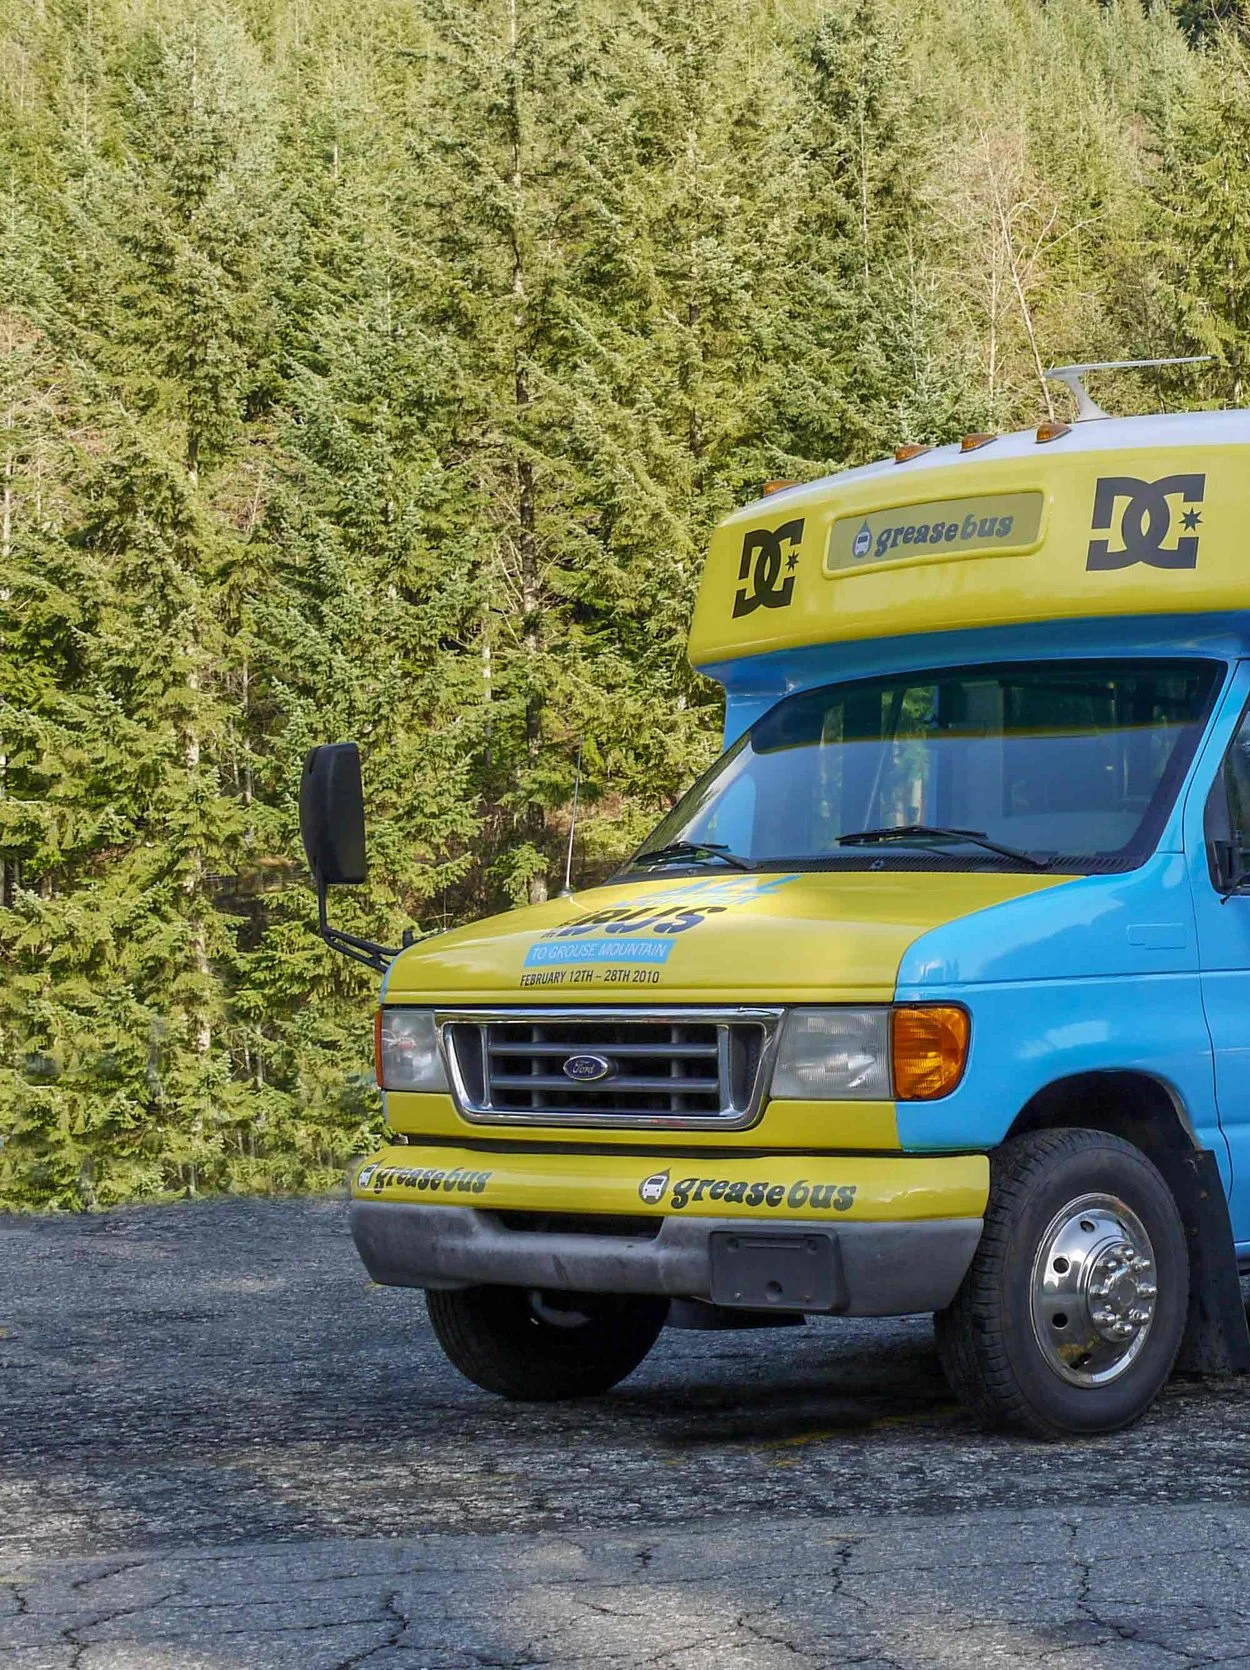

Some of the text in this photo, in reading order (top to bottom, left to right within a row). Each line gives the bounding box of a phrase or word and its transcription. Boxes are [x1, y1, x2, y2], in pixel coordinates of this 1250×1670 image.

[1085, 474, 1206, 571] DC
[731, 518, 805, 618] DC
[557, 906, 728, 937] BUS
[531, 942, 668, 960] TO GROUSE MOUNTAIN
[520, 970, 566, 986] FEBRUARY
[569, 970, 593, 983] 12TH
[604, 970, 630, 982] 28TH
[632, 970, 660, 984] 2010
